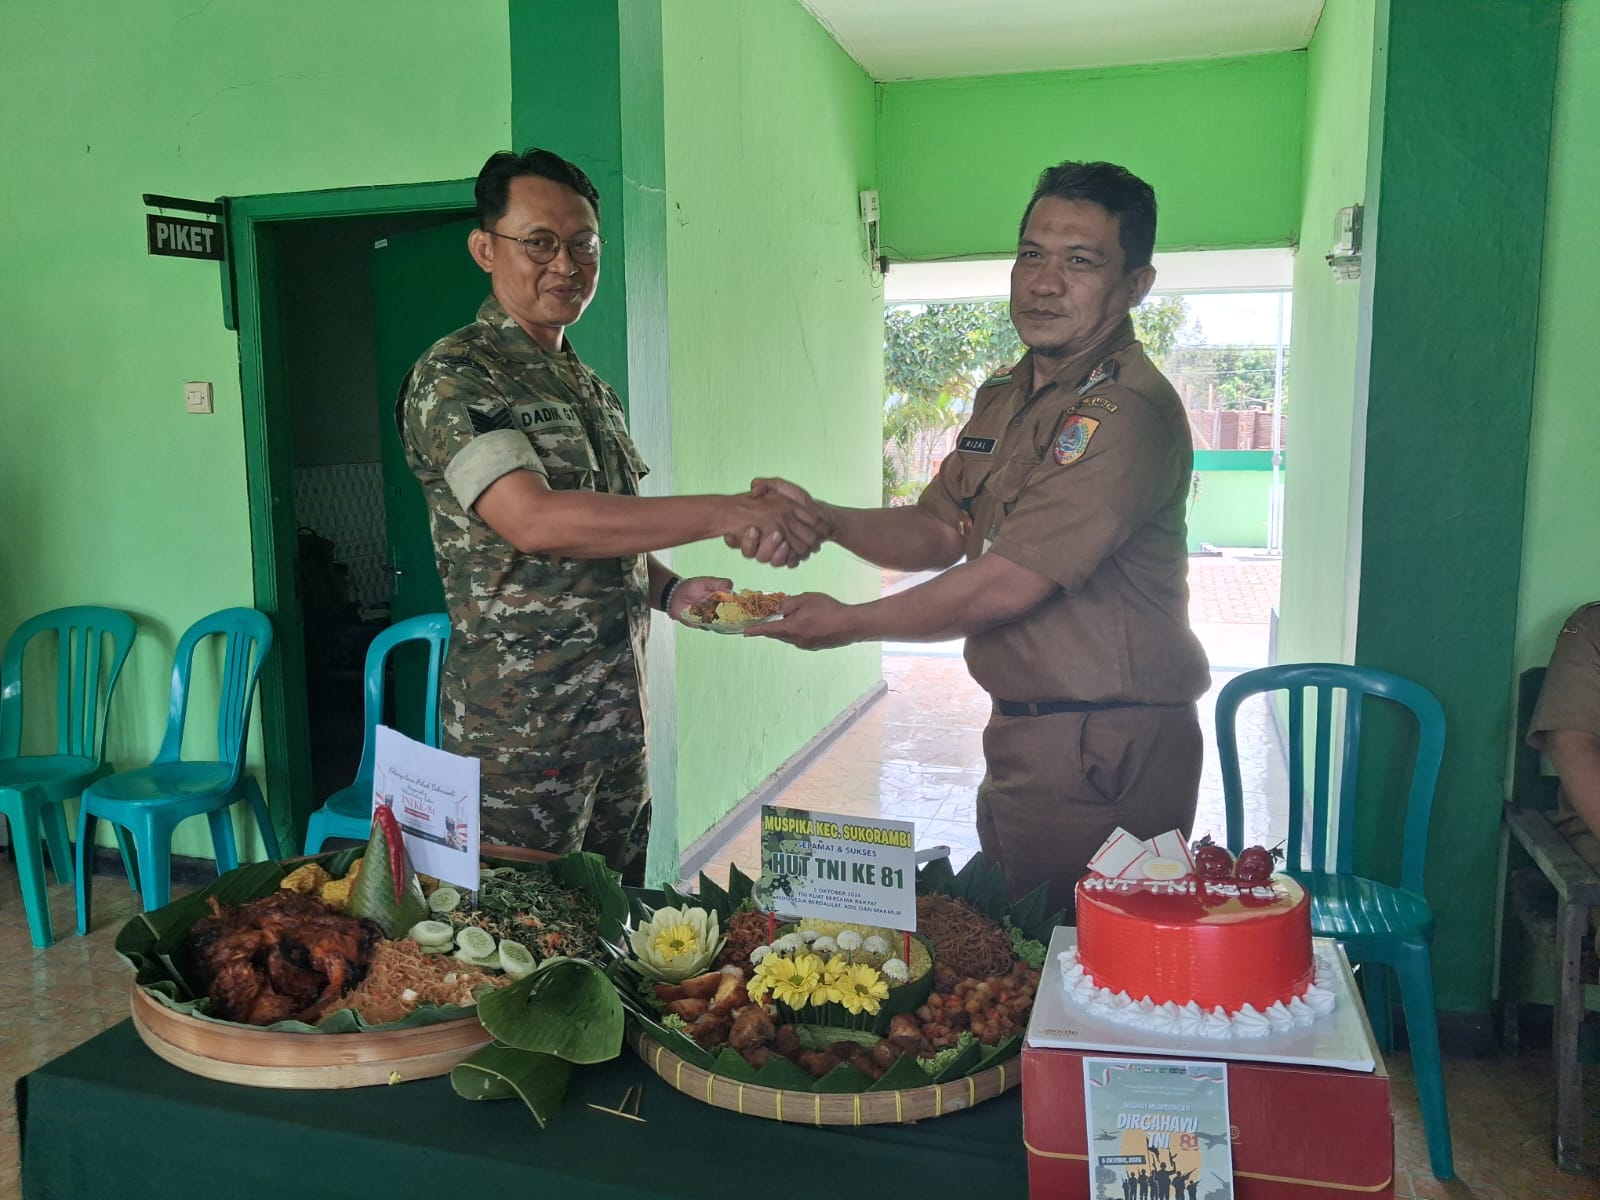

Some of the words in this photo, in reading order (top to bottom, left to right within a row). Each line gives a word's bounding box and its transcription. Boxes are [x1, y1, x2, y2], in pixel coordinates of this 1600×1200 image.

[156, 222, 214, 253] PIKET
[521, 408, 562, 427] DADIK
[965, 441, 987, 450] RIZAL
[764, 816, 814, 835] MUSPIKA
[815, 820, 842, 839] KEC.
[843, 823, 912, 848] SUKORAMBI
[797, 841, 834, 852] SELAMAT
[846, 846, 877, 857] SUKSES
[771, 852, 810, 877] HUT
[815, 858, 846, 882] TNI
[852, 862, 876, 886] KE
[881, 866, 904, 890] 81
[819, 888, 846, 896] OKTOBER
[1143, 880, 1197, 893] TNI
[825, 894, 853, 903] BERSAMA
[855, 898, 878, 906] RAKYAT
[1117, 1113, 1199, 1133] DIRGAHAYU
[1147, 1131, 1171, 1149] TNI
